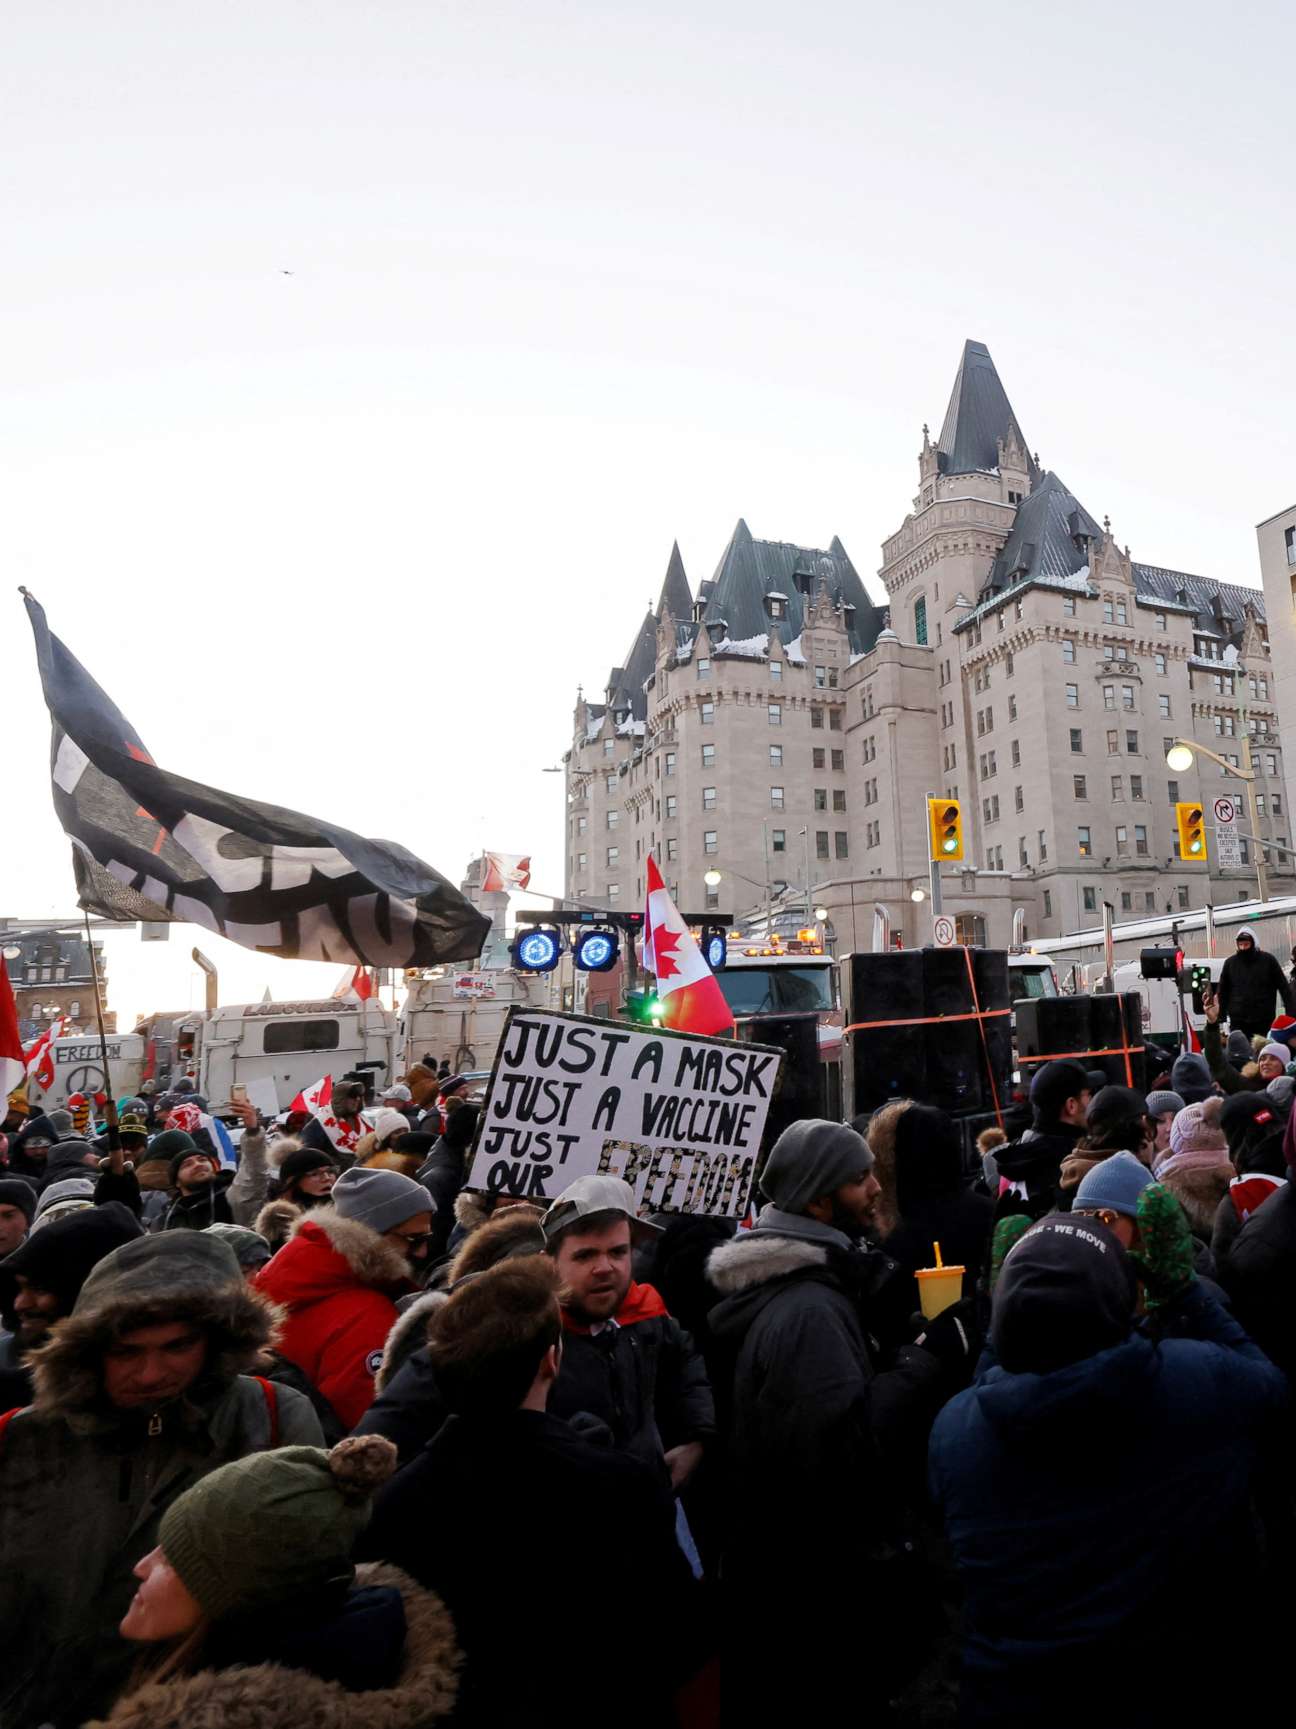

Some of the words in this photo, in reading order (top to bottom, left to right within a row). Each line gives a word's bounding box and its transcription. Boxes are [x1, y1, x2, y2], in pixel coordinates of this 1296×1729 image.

[503, 1019, 630, 1077] JUST
[631, 1041, 664, 1083] A
[674, 1047, 773, 1098] MASK
[494, 1073, 582, 1126] JUST
[591, 1086, 622, 1131] A
[641, 1092, 756, 1147] VACCINE
[484, 1126, 580, 1164] JUST
[487, 1160, 553, 1197] OUR
[1054, 1224, 1074, 1235] WE
[1076, 1228, 1107, 1254] MOVE
